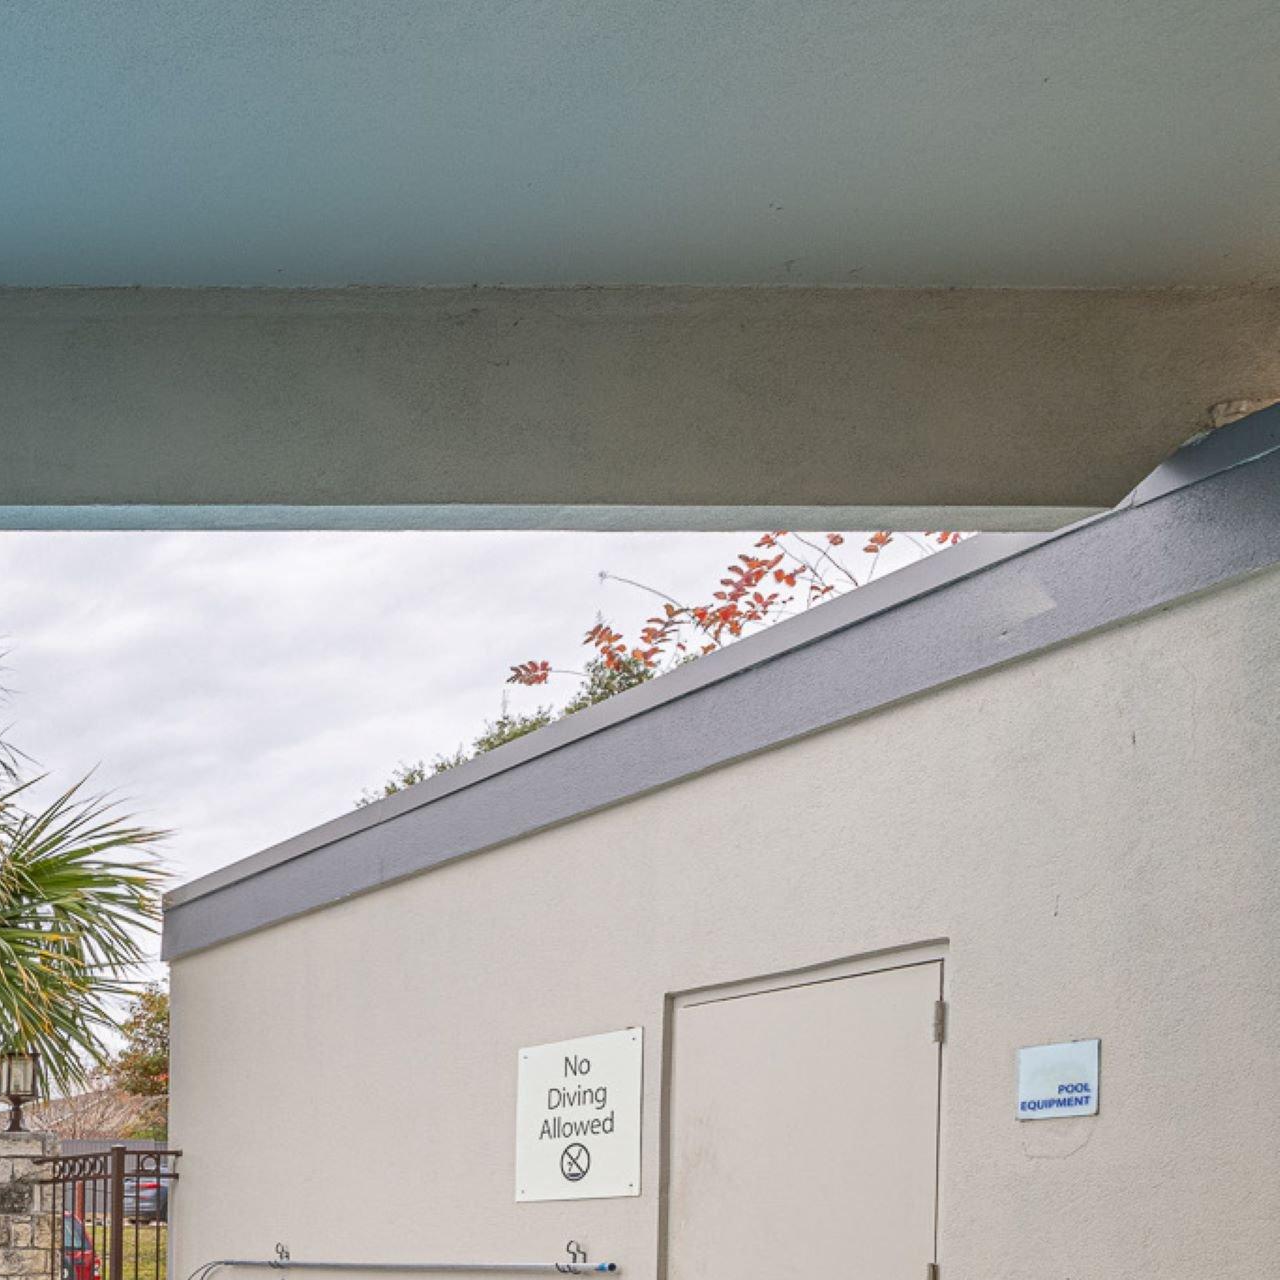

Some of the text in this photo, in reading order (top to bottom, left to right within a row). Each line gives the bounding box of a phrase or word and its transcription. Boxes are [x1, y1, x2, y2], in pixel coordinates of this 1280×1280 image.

[564, 1055, 591, 1078] No
[547, 1085, 608, 1110] Diving
[1057, 1082, 1091, 1095] POOL
[1019, 1096, 1091, 1112] EQUIPMENT
[538, 1110, 615, 1140] Allowed
